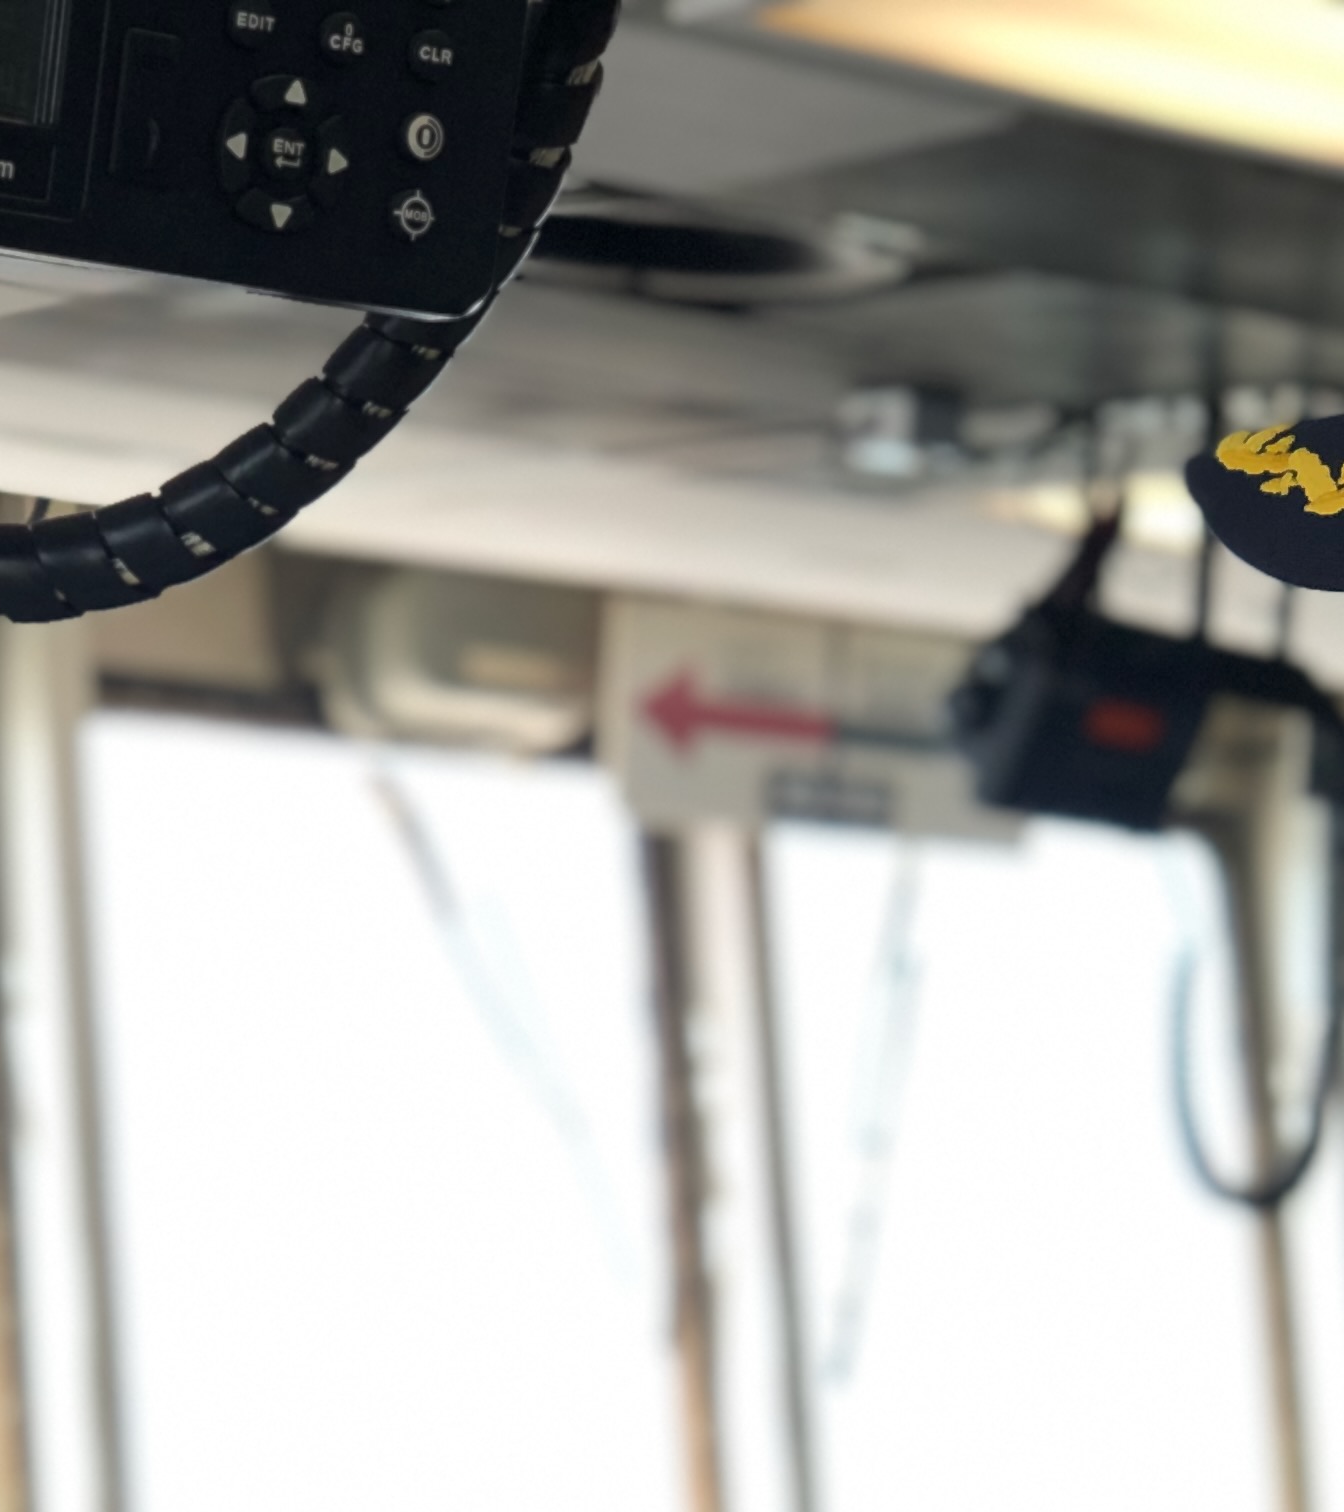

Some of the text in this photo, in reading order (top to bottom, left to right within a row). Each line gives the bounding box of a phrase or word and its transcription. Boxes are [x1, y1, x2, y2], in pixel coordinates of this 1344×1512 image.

[237, 11, 276, 33] EDIT
[329, 34, 364, 55] CFG
[418, 46, 454, 66] CLR
[272, 138, 306, 156] ENT
[404, 207, 429, 222] MOB
